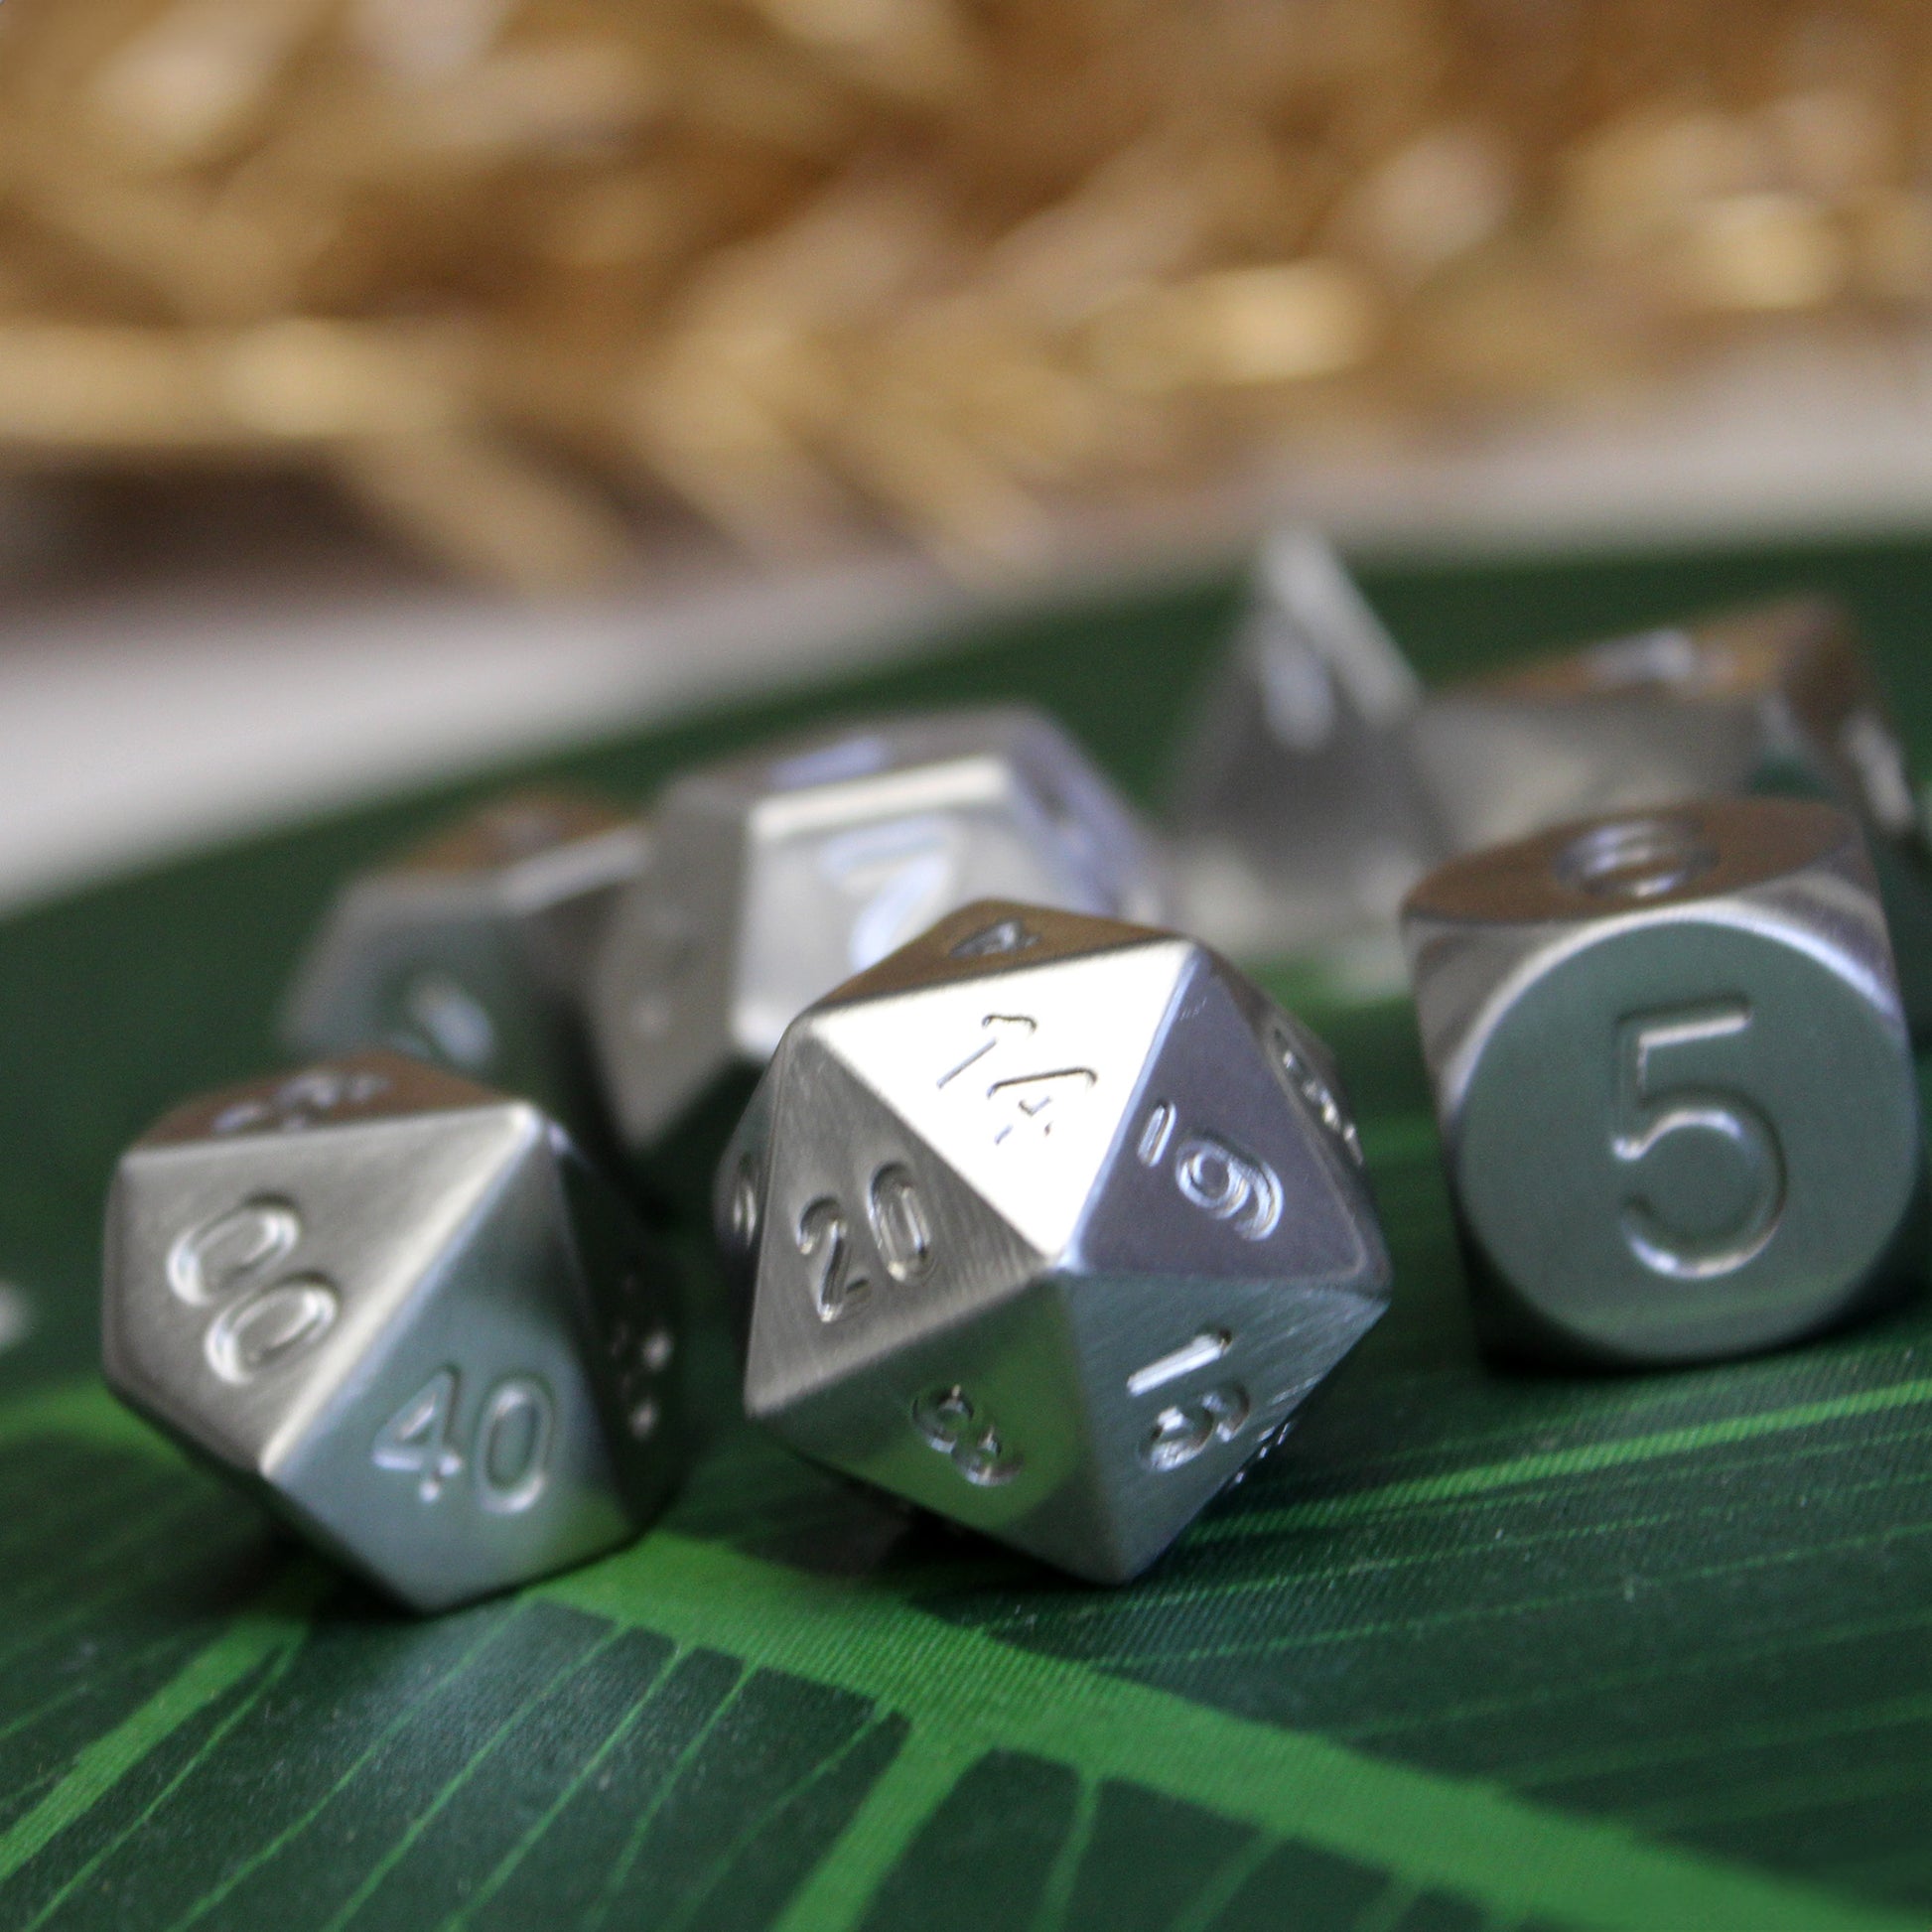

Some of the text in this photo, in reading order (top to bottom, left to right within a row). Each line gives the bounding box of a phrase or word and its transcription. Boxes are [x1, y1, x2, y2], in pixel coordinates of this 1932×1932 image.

[1610, 993, 1787, 1279] 5
[795, 1161, 935, 1322] 20
[371, 1361, 555, 1514] 40
